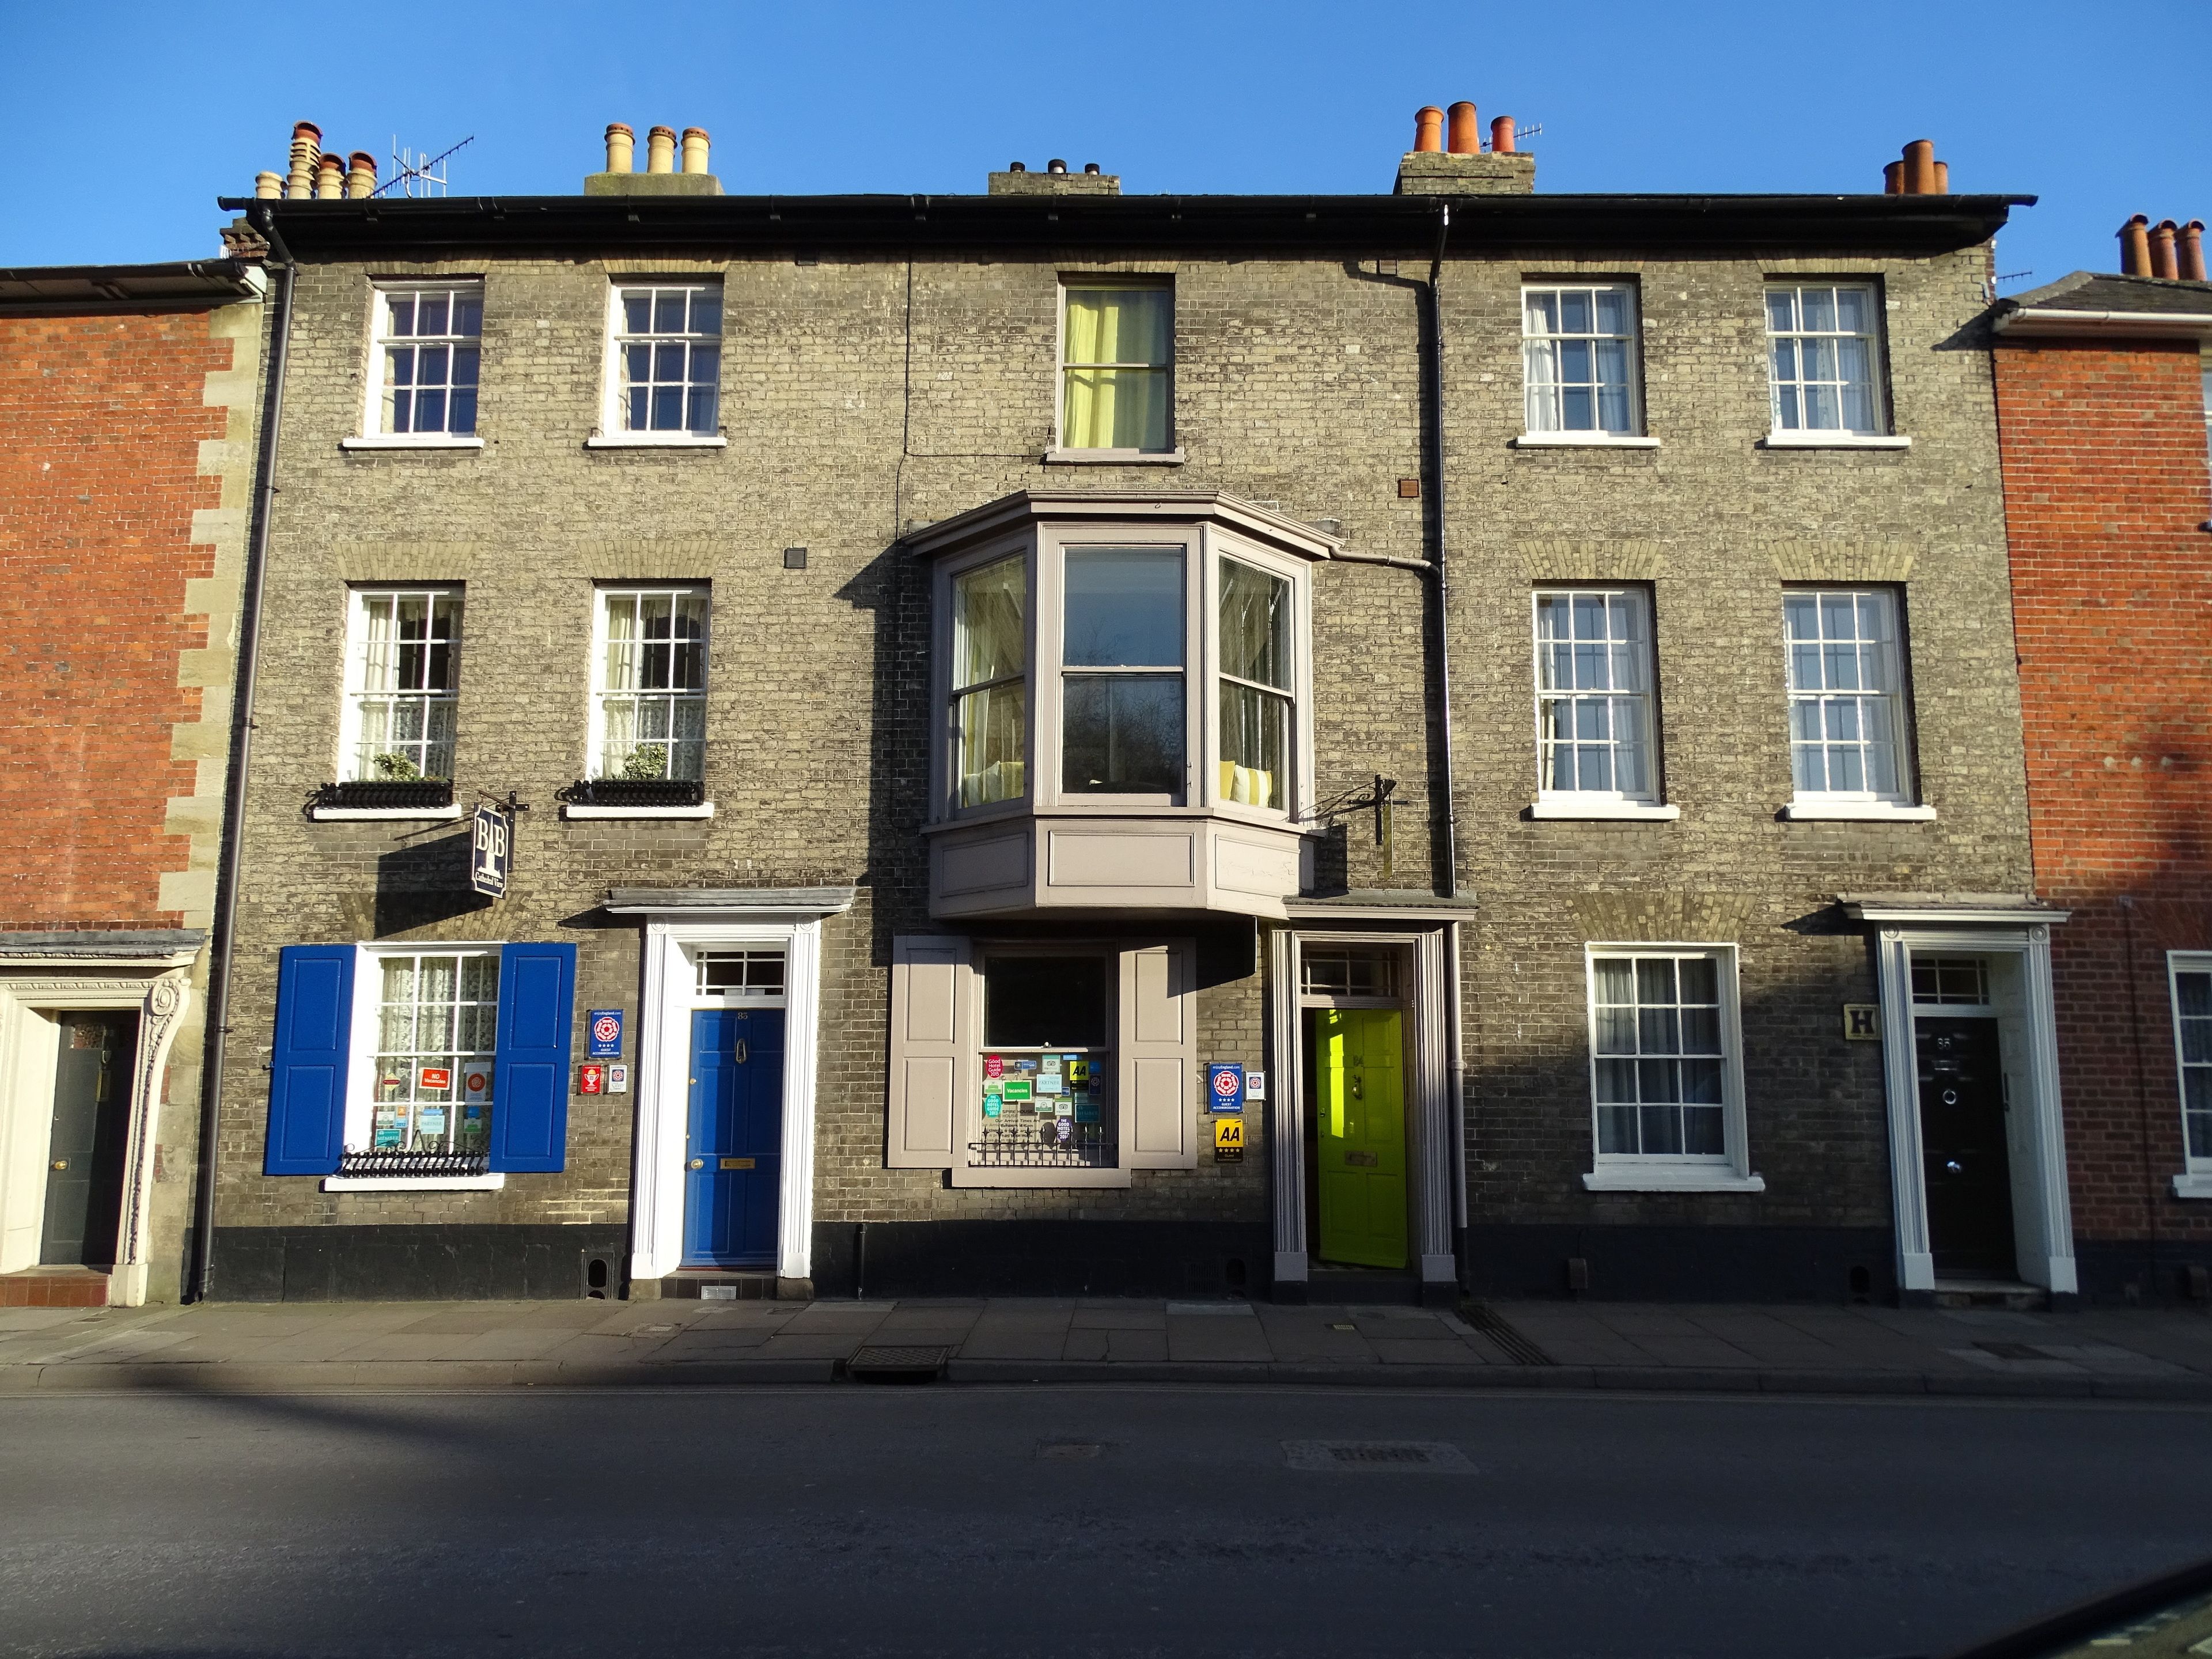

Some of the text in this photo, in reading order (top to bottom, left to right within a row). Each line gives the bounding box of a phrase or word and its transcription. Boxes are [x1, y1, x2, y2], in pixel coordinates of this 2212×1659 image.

[475, 872, 503, 888] Cathedral View
[1849, 1010, 1874, 1034] H
[1073, 1066, 1086, 1076] AA
[1219, 1127, 1240, 1142] AA
